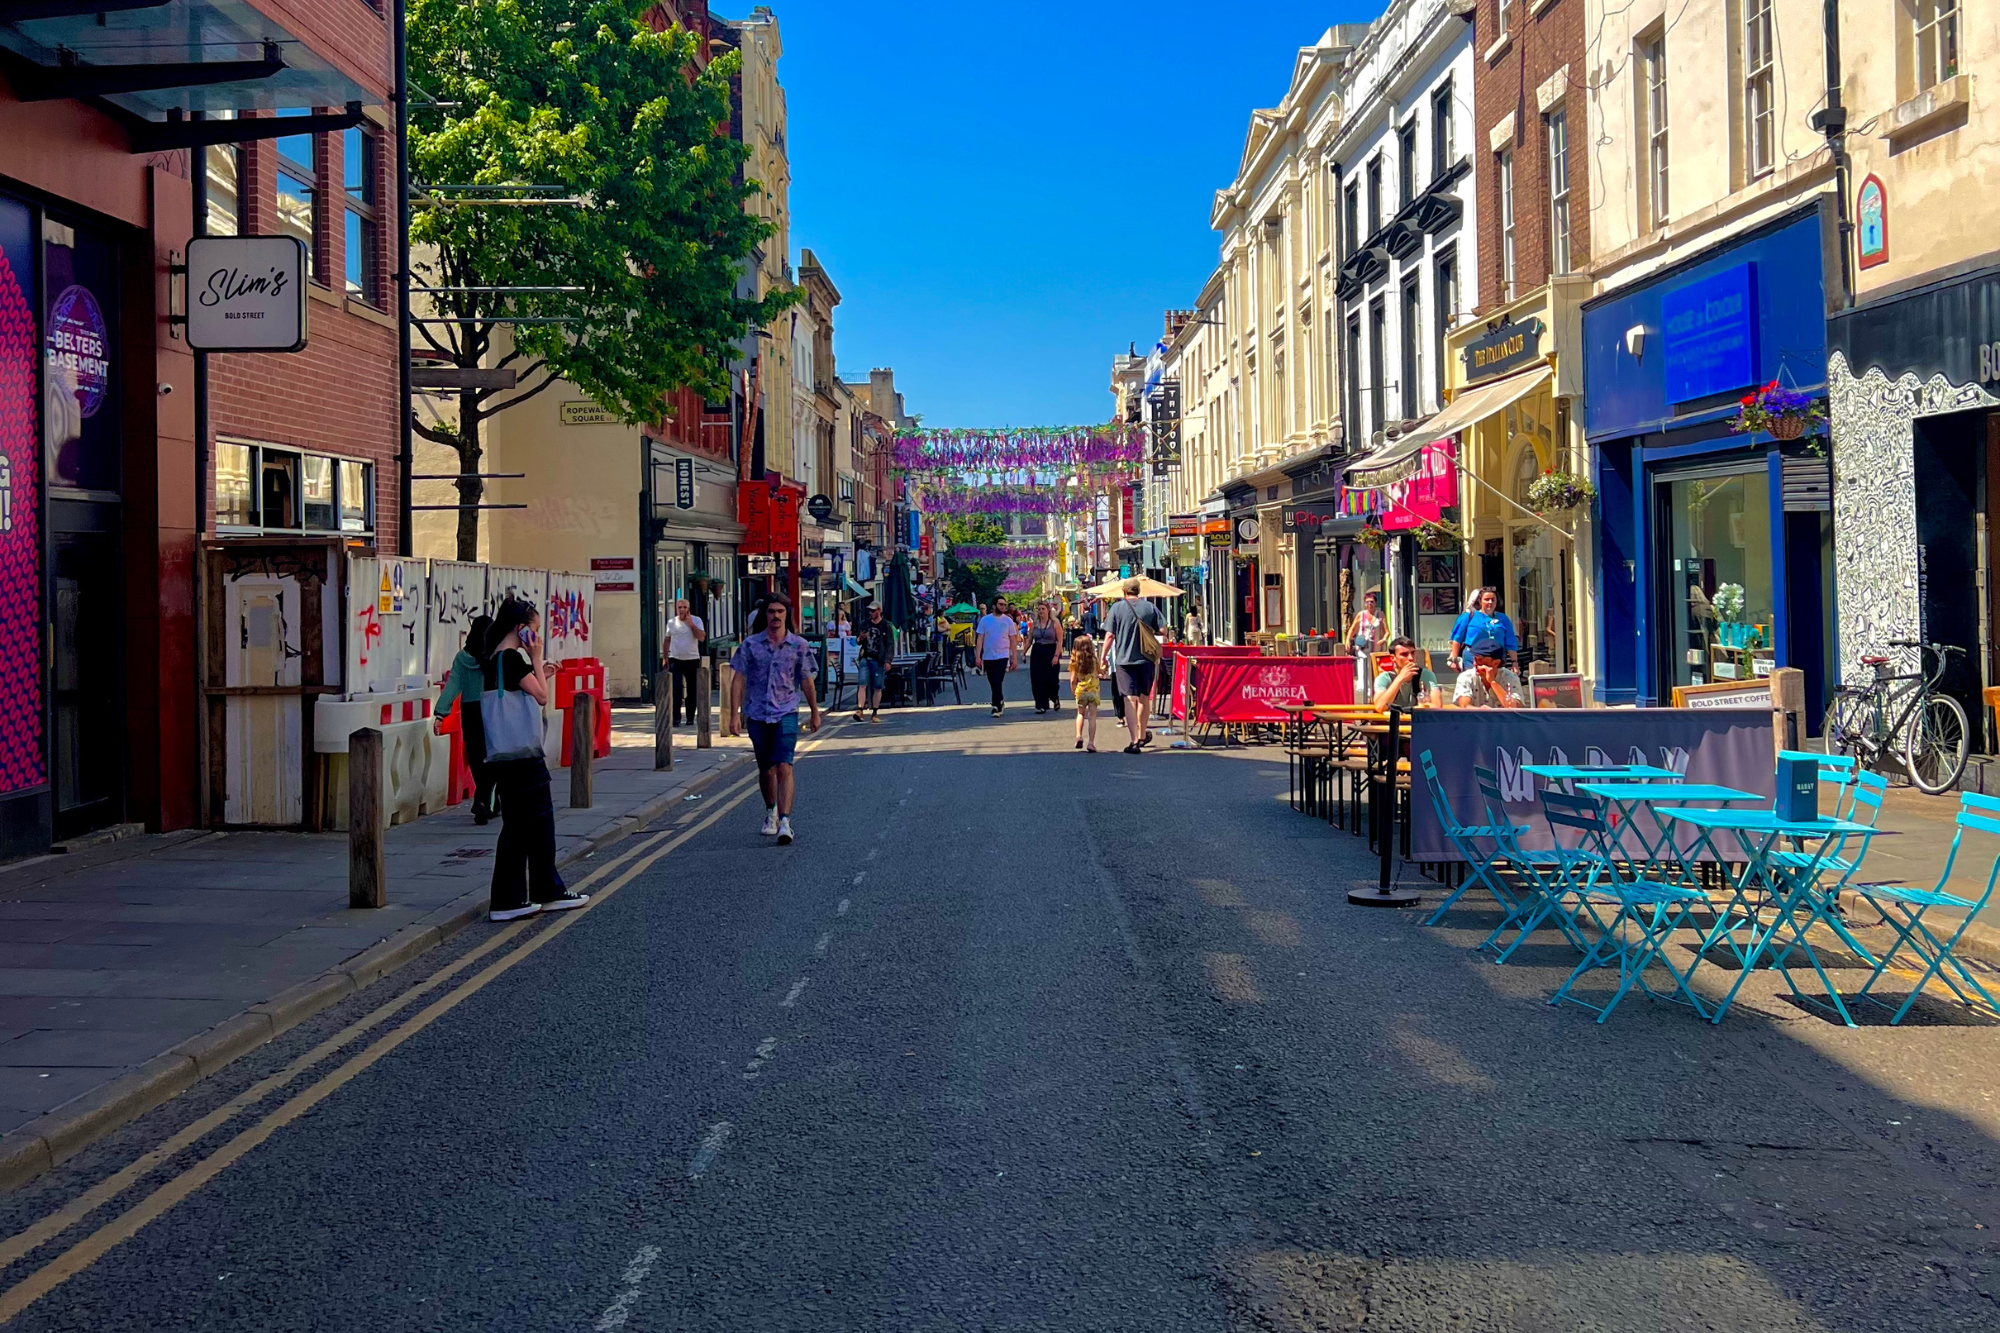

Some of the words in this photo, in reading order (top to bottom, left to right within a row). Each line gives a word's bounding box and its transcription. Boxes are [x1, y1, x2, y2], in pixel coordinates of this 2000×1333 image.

[199, 267, 288, 306] Slim's
[55, 331, 103, 357] BELTERS
[47, 348, 109, 377] BASEMENT
[566, 406, 612, 414] ROPEWAL
[1169, 390, 1177, 449] TATTOO
[679, 462, 690, 504] HONEST
[1210, 533, 1231, 541] BOLD
[1242, 685, 1308, 700] MENABREA
[1691, 700, 1714, 708] BOLD
[1714, 697, 1743, 706] STREET
[1744, 694, 1770, 703] COFFE
